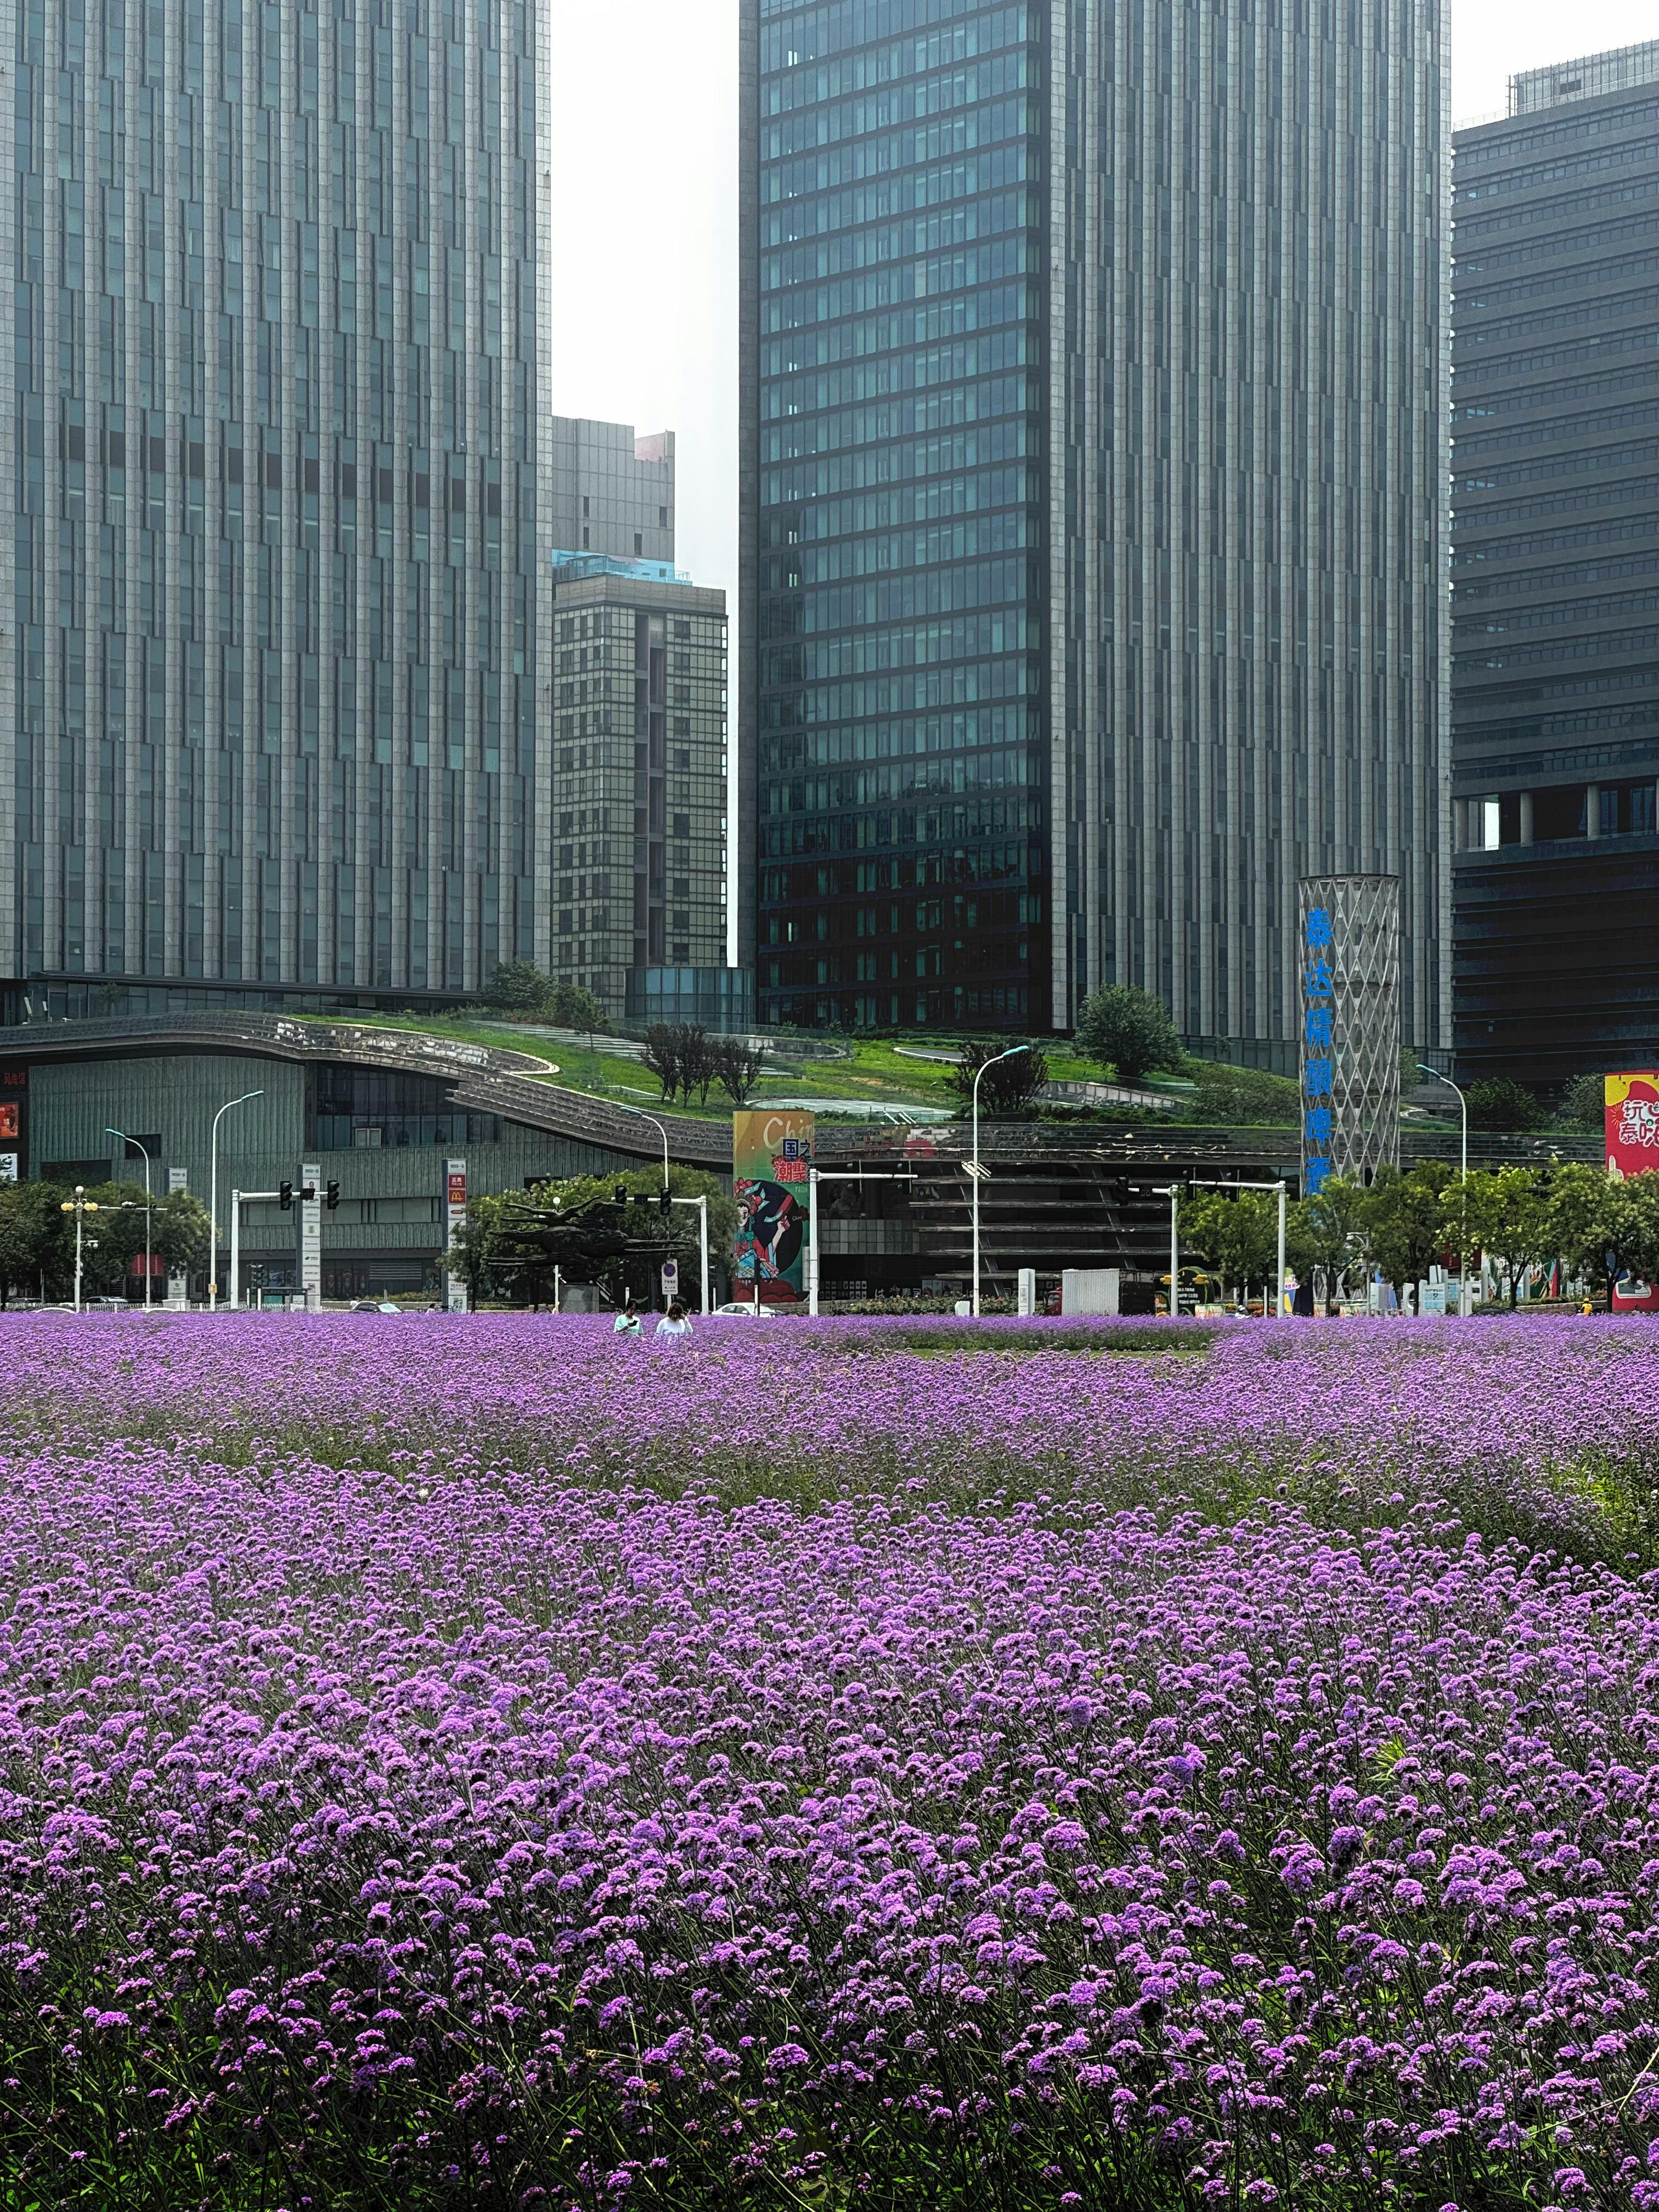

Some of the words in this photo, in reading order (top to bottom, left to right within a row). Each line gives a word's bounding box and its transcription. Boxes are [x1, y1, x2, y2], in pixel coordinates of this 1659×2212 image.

[1306, 908, 1333, 1229] 泰达精酿啤酒
[774, 1161, 808, 1183] 潮聚
